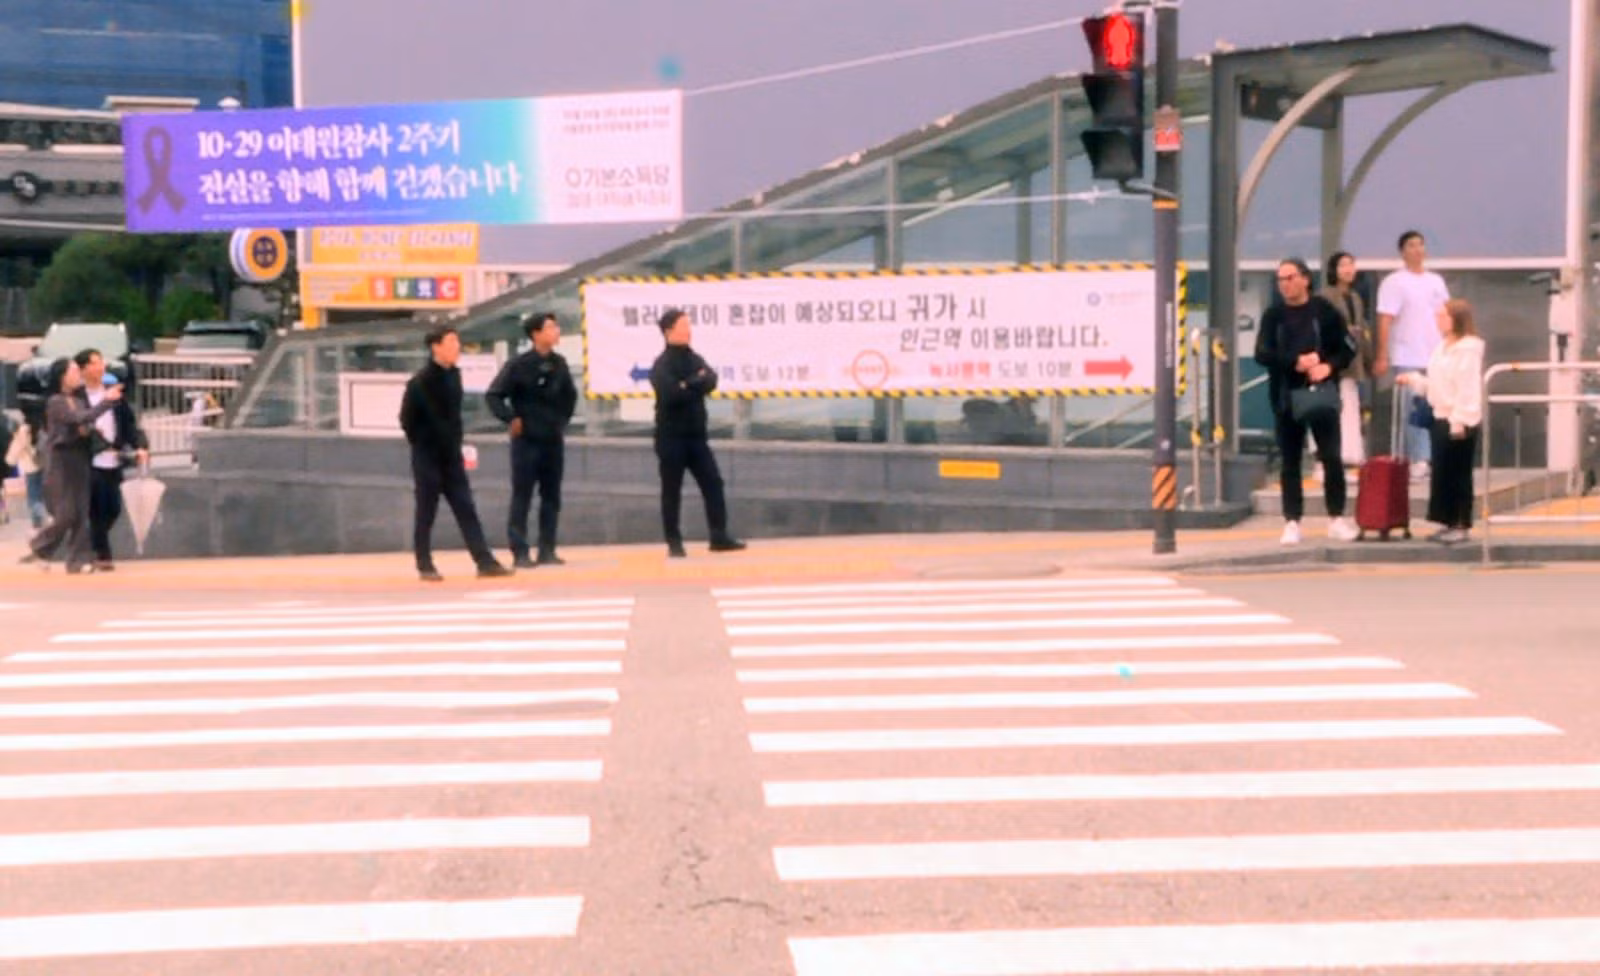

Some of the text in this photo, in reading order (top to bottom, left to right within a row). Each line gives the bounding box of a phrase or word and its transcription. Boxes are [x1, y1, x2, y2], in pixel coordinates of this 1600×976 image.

[267, 122, 393, 160] 이태원참사
[397, 119, 461, 158] 2주기
[198, 168, 274, 205] 진실을
[276, 166, 331, 203] 향해
[334, 165, 388, 202] 함께
[394, 160, 523, 200] 걷겠습니다
[728, 302, 786, 326] 혼잡이
[795, 299, 897, 323] 예상되오니
[907, 293, 958, 321] 귀가
[967, 297, 986, 320] 시
[899, 325, 1110, 352] 인근역 이용바랍니다.
[741, 364, 769, 382] 도보
[998, 360, 1029, 378] 도보
[1037, 360, 1073, 378] 10분
